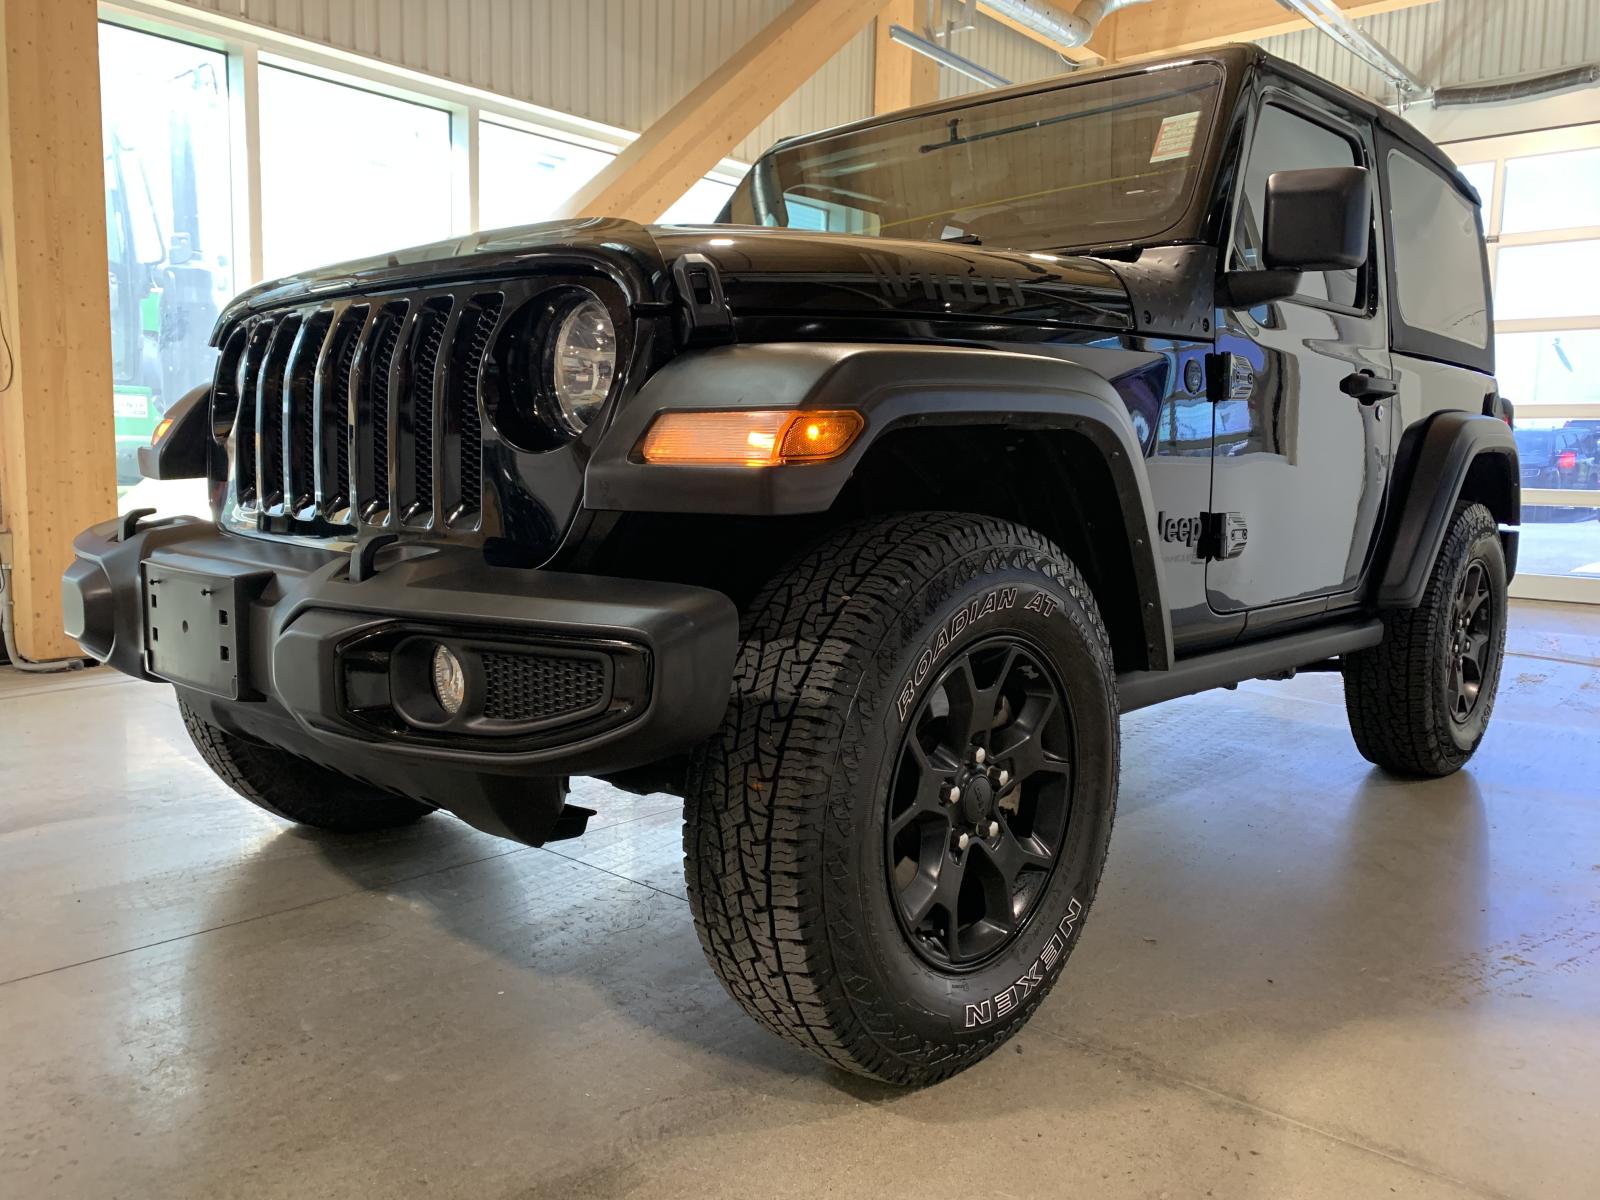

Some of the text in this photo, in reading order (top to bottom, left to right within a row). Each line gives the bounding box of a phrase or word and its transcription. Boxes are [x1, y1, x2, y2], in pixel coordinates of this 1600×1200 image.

[1158, 511, 1202, 547] Jeep
[897, 588, 1018, 722] ROADIAN
[1024, 591, 1058, 618] AT
[965, 897, 1083, 1028] NEXEN
